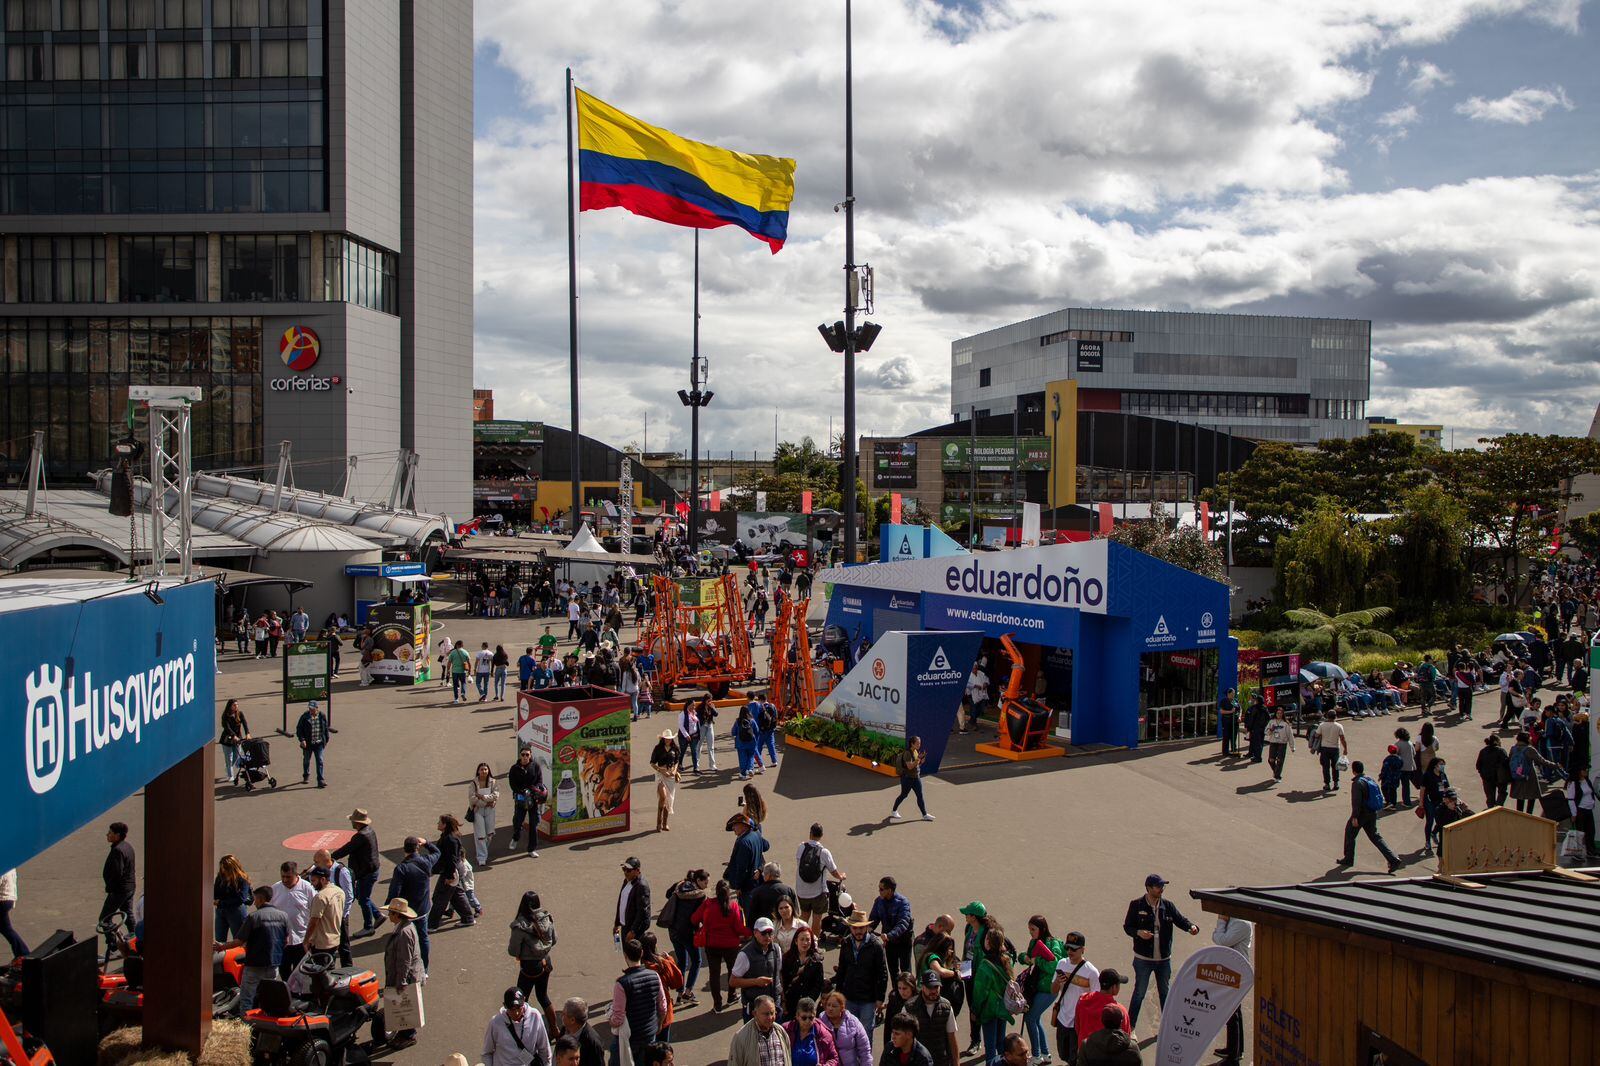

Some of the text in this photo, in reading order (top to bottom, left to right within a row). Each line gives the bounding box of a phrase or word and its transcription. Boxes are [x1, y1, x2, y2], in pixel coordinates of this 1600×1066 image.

[270, 374, 330, 390] corferias
[946, 559, 1103, 606] eduardoño
[846, 597, 862, 606] YAMAHA
[947, 607, 1045, 629] www.eduardono.com
[1145, 635, 1177, 643] eduardoño
[1171, 656, 1196, 666] OREGON
[1267, 661, 1282, 669] BAÑOS
[917, 670, 962, 681] eduardoño
[857, 682, 900, 704] JACTO
[69, 652, 194, 761] Husqvarna
[580, 725, 627, 739] Garatox
[1201, 968, 1236, 983] MANDRA
[1184, 998, 1216, 1010] MANTO
[1174, 1025, 1201, 1037] VISUR
